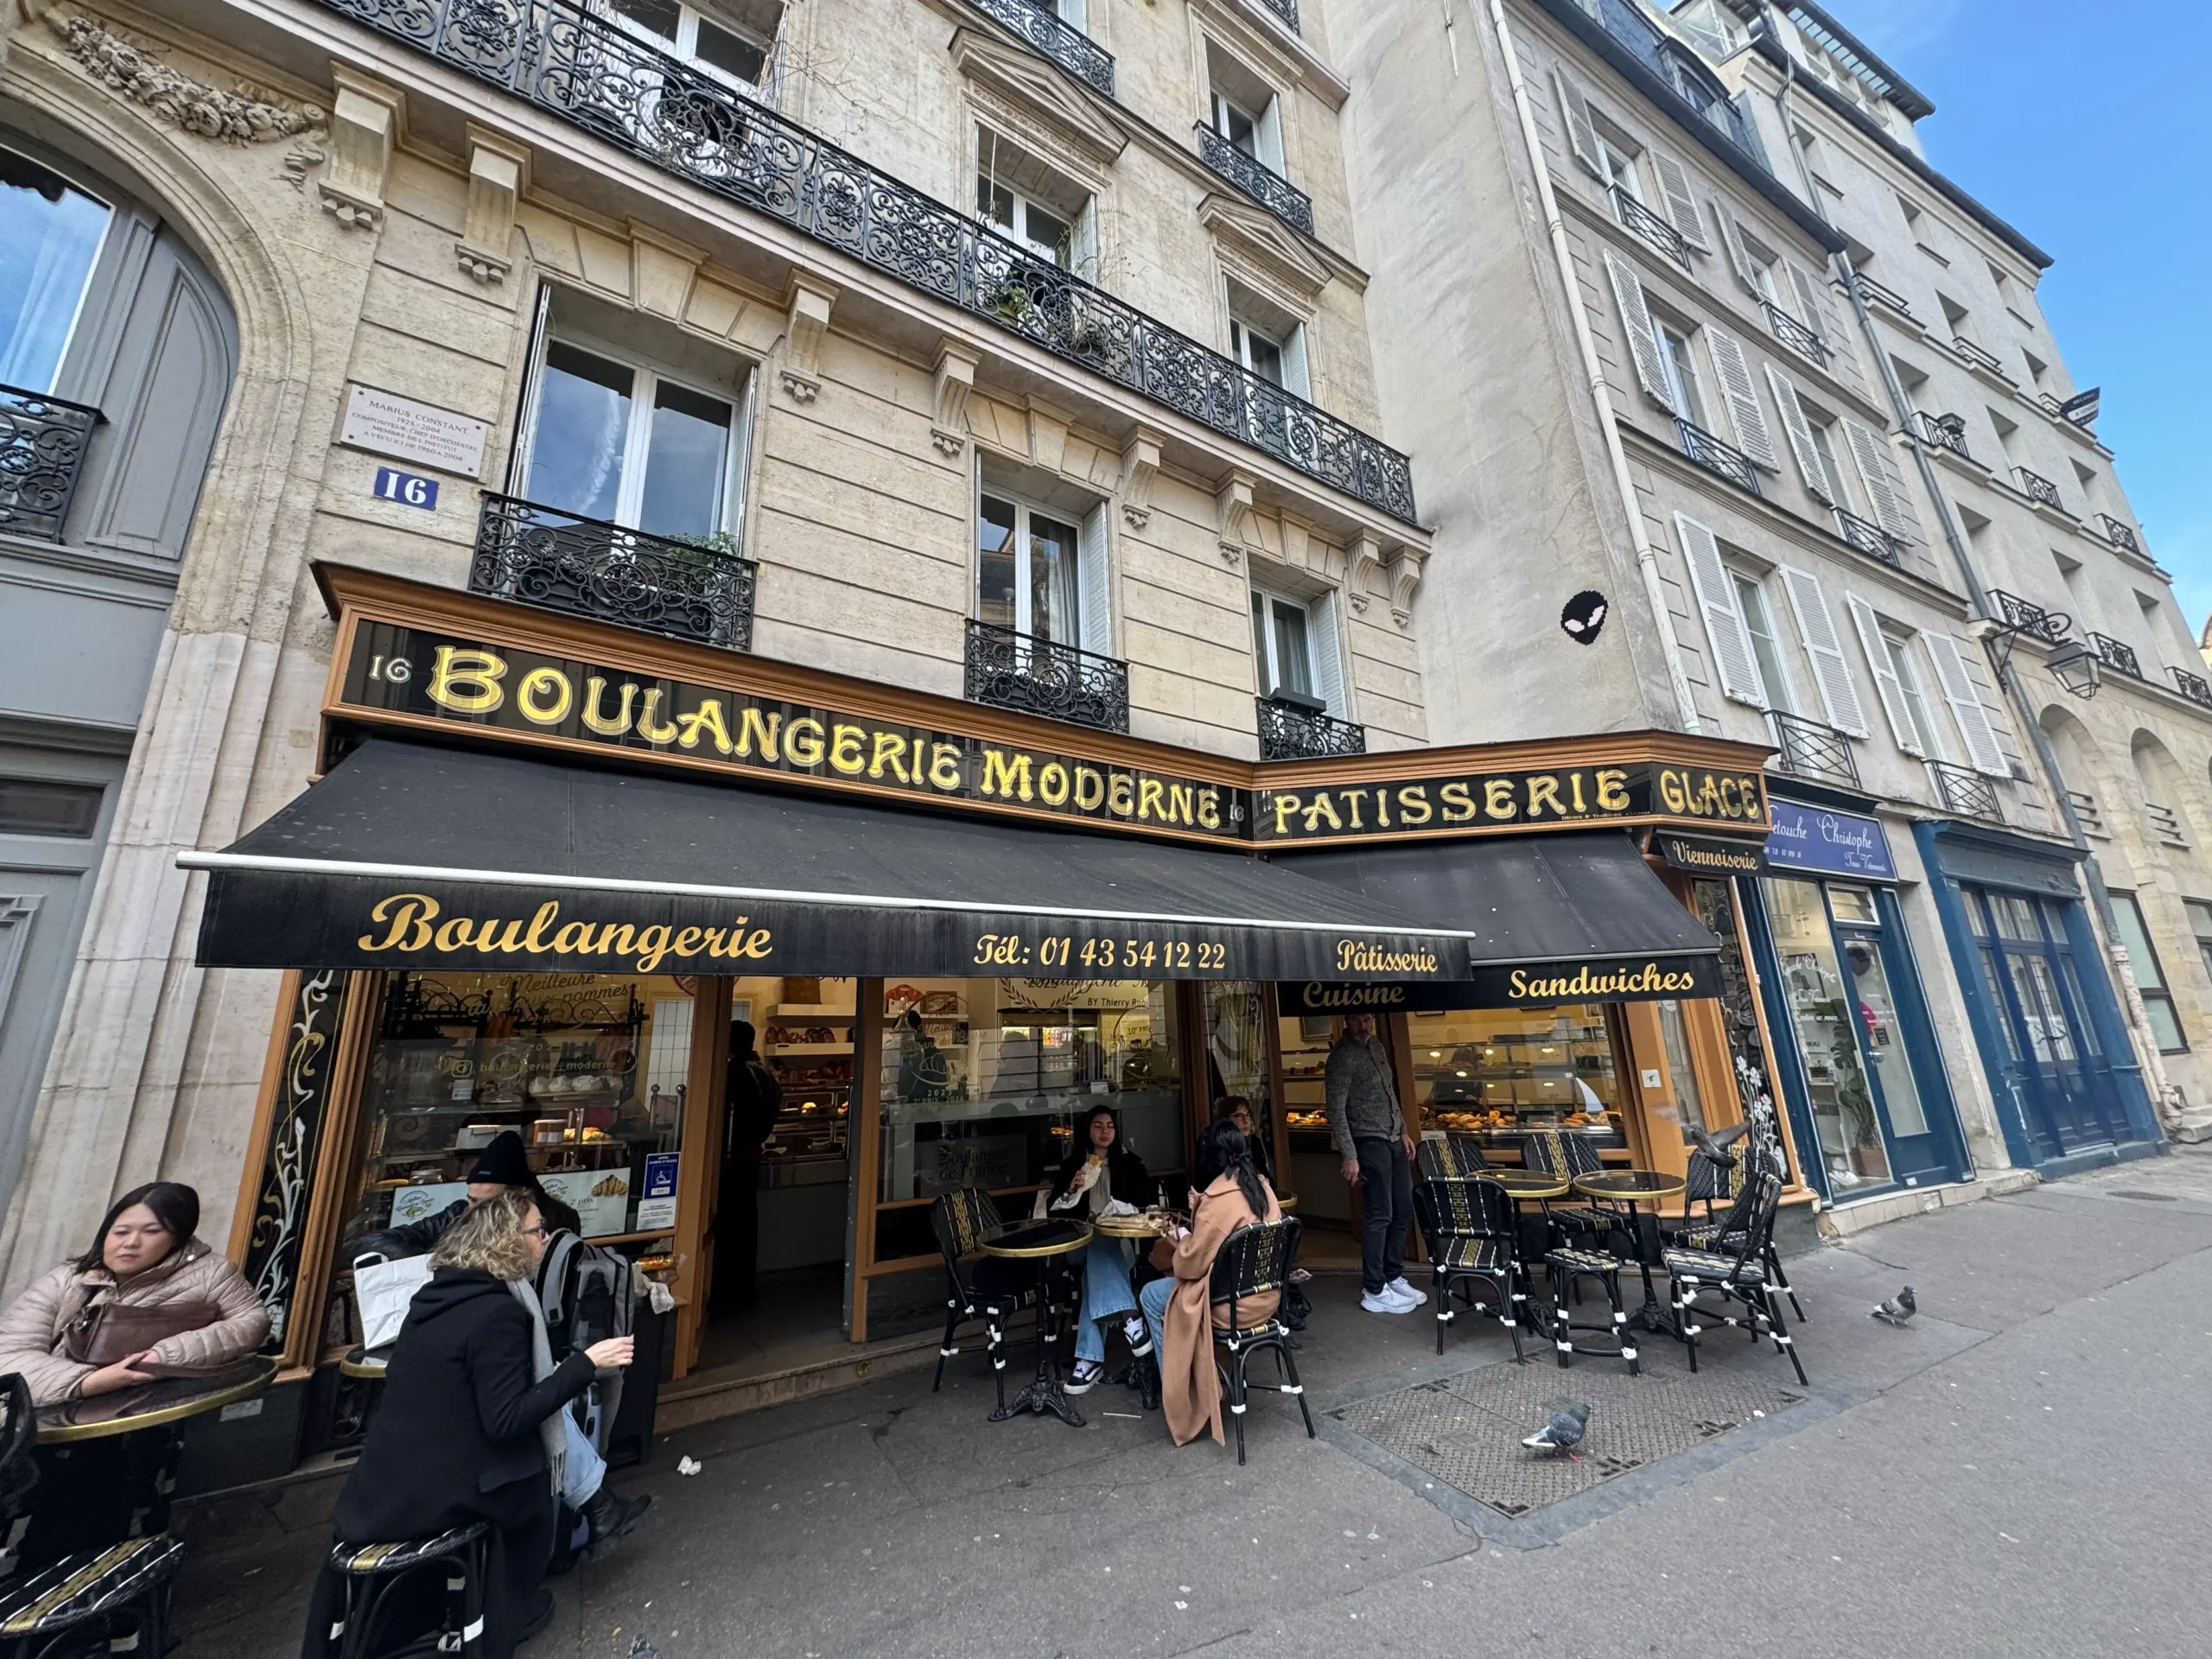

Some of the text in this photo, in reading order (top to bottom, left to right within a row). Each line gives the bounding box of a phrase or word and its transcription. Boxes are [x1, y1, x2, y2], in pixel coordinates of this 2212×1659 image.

[370, 400, 469, 435] MARIUS CONSTANT
[397, 416, 415, 428] 1925
[421, 423, 441, 434] 2004
[410, 427, 430, 437] CHEF
[372, 425, 405, 439] MEMBRE
[407, 434, 416, 442] DE
[393, 437, 404, 446] ICI
[417, 444, 435, 454] 1960
[444, 452, 462, 462] 2004
[385, 473, 427, 504] 16
[369, 645, 1244, 830] 16 BOULANGERIE MODERNE 16
[1274, 768, 1760, 834] PATISSERIE GLACE
[1769, 804, 1872, 855] etouche Christophe
[1672, 839, 1758, 871] Viennoiserie
[359, 893, 772, 972] Boulangerie
[1040, 936, 1071, 966] 01
[1079, 938, 1115, 968] 43
[1122, 940, 1157, 968] 54
[1163, 941, 1191, 968] 12
[1198, 942, 1225, 969] 22
[1336, 938, 1438, 974] Pâtisserie
[500, 974, 595, 993] Meilleure
[562, 983, 630, 1003] pommes
[1303, 981, 1405, 1007] Cuisine
[1508, 962, 1694, 999] Sandwiches
[1087, 998, 1099, 1007] BY
[1102, 997, 1129, 1008] Thierry
